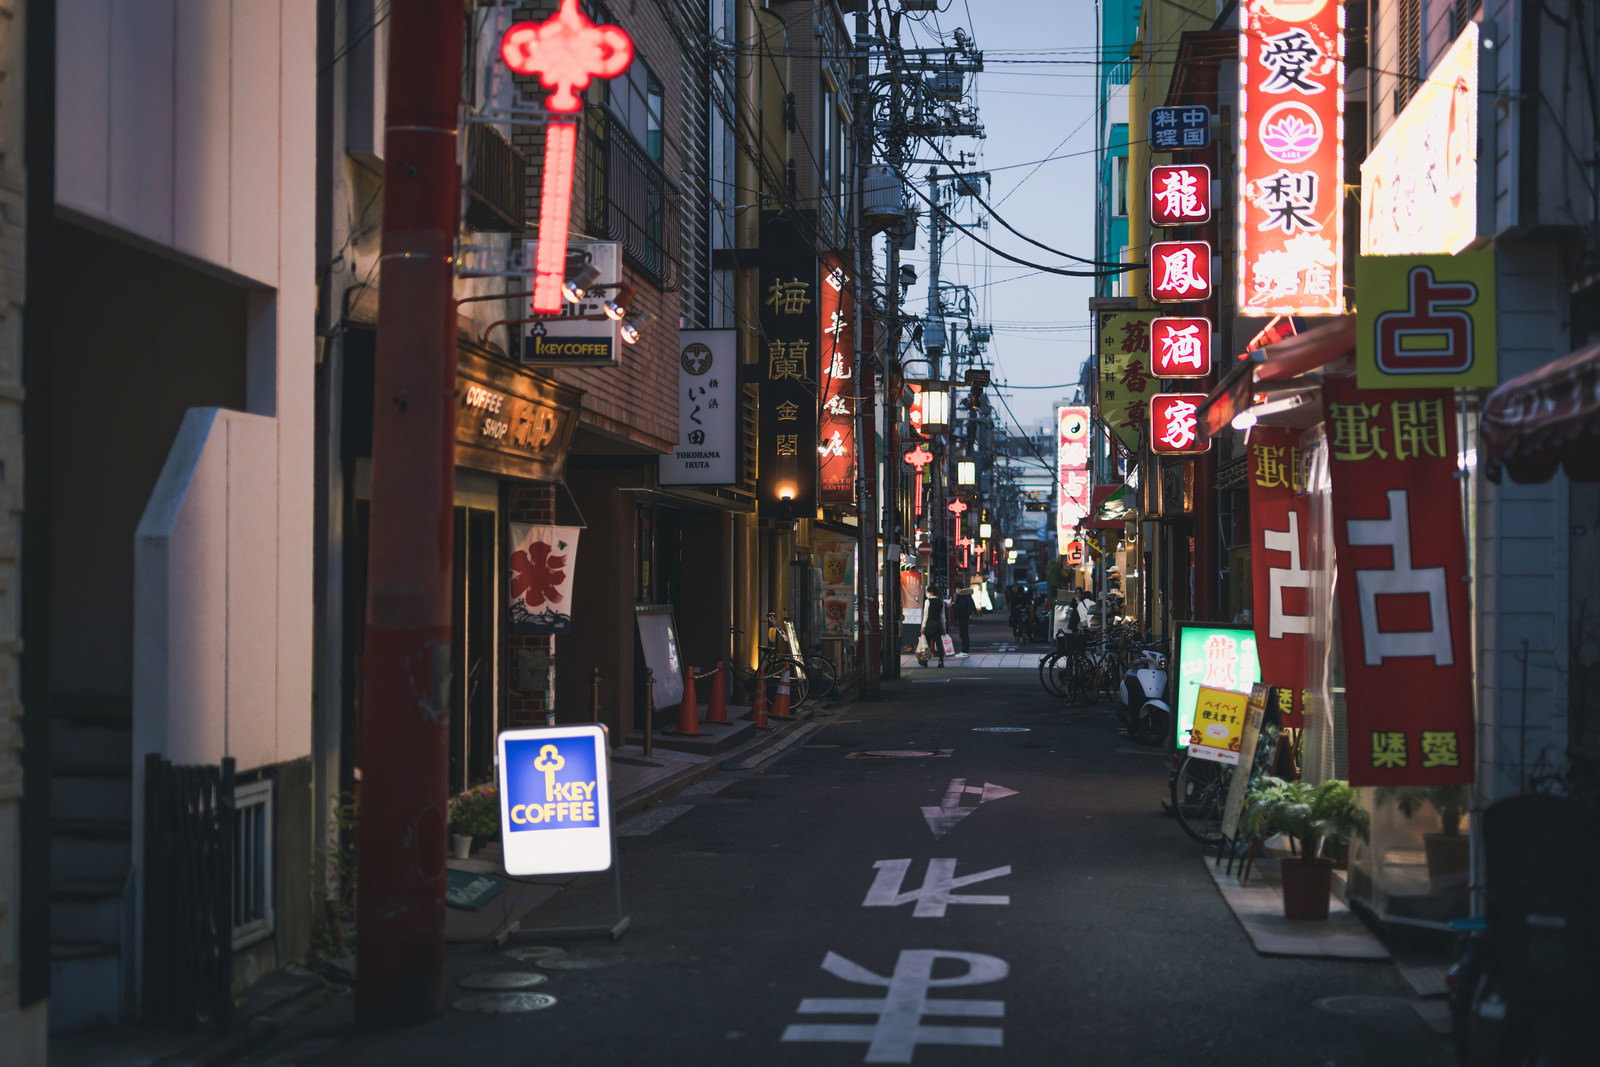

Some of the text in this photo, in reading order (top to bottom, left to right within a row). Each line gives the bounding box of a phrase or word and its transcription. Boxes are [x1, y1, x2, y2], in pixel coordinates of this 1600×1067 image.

[1374, 264, 1478, 375] 占
[564, 344, 608, 355] COFFEE
[466, 386, 504, 414] COFFEE
[709, 378, 719, 409] 横浜
[688, 386, 706, 445] いく田
[483, 418, 508, 440] SHOP
[676, 451, 720, 459] YOKOHAMA
[685, 461, 710, 469] IKUTA
[545, 780, 596, 802] KEY
[511, 801, 596, 824] COFFEE
